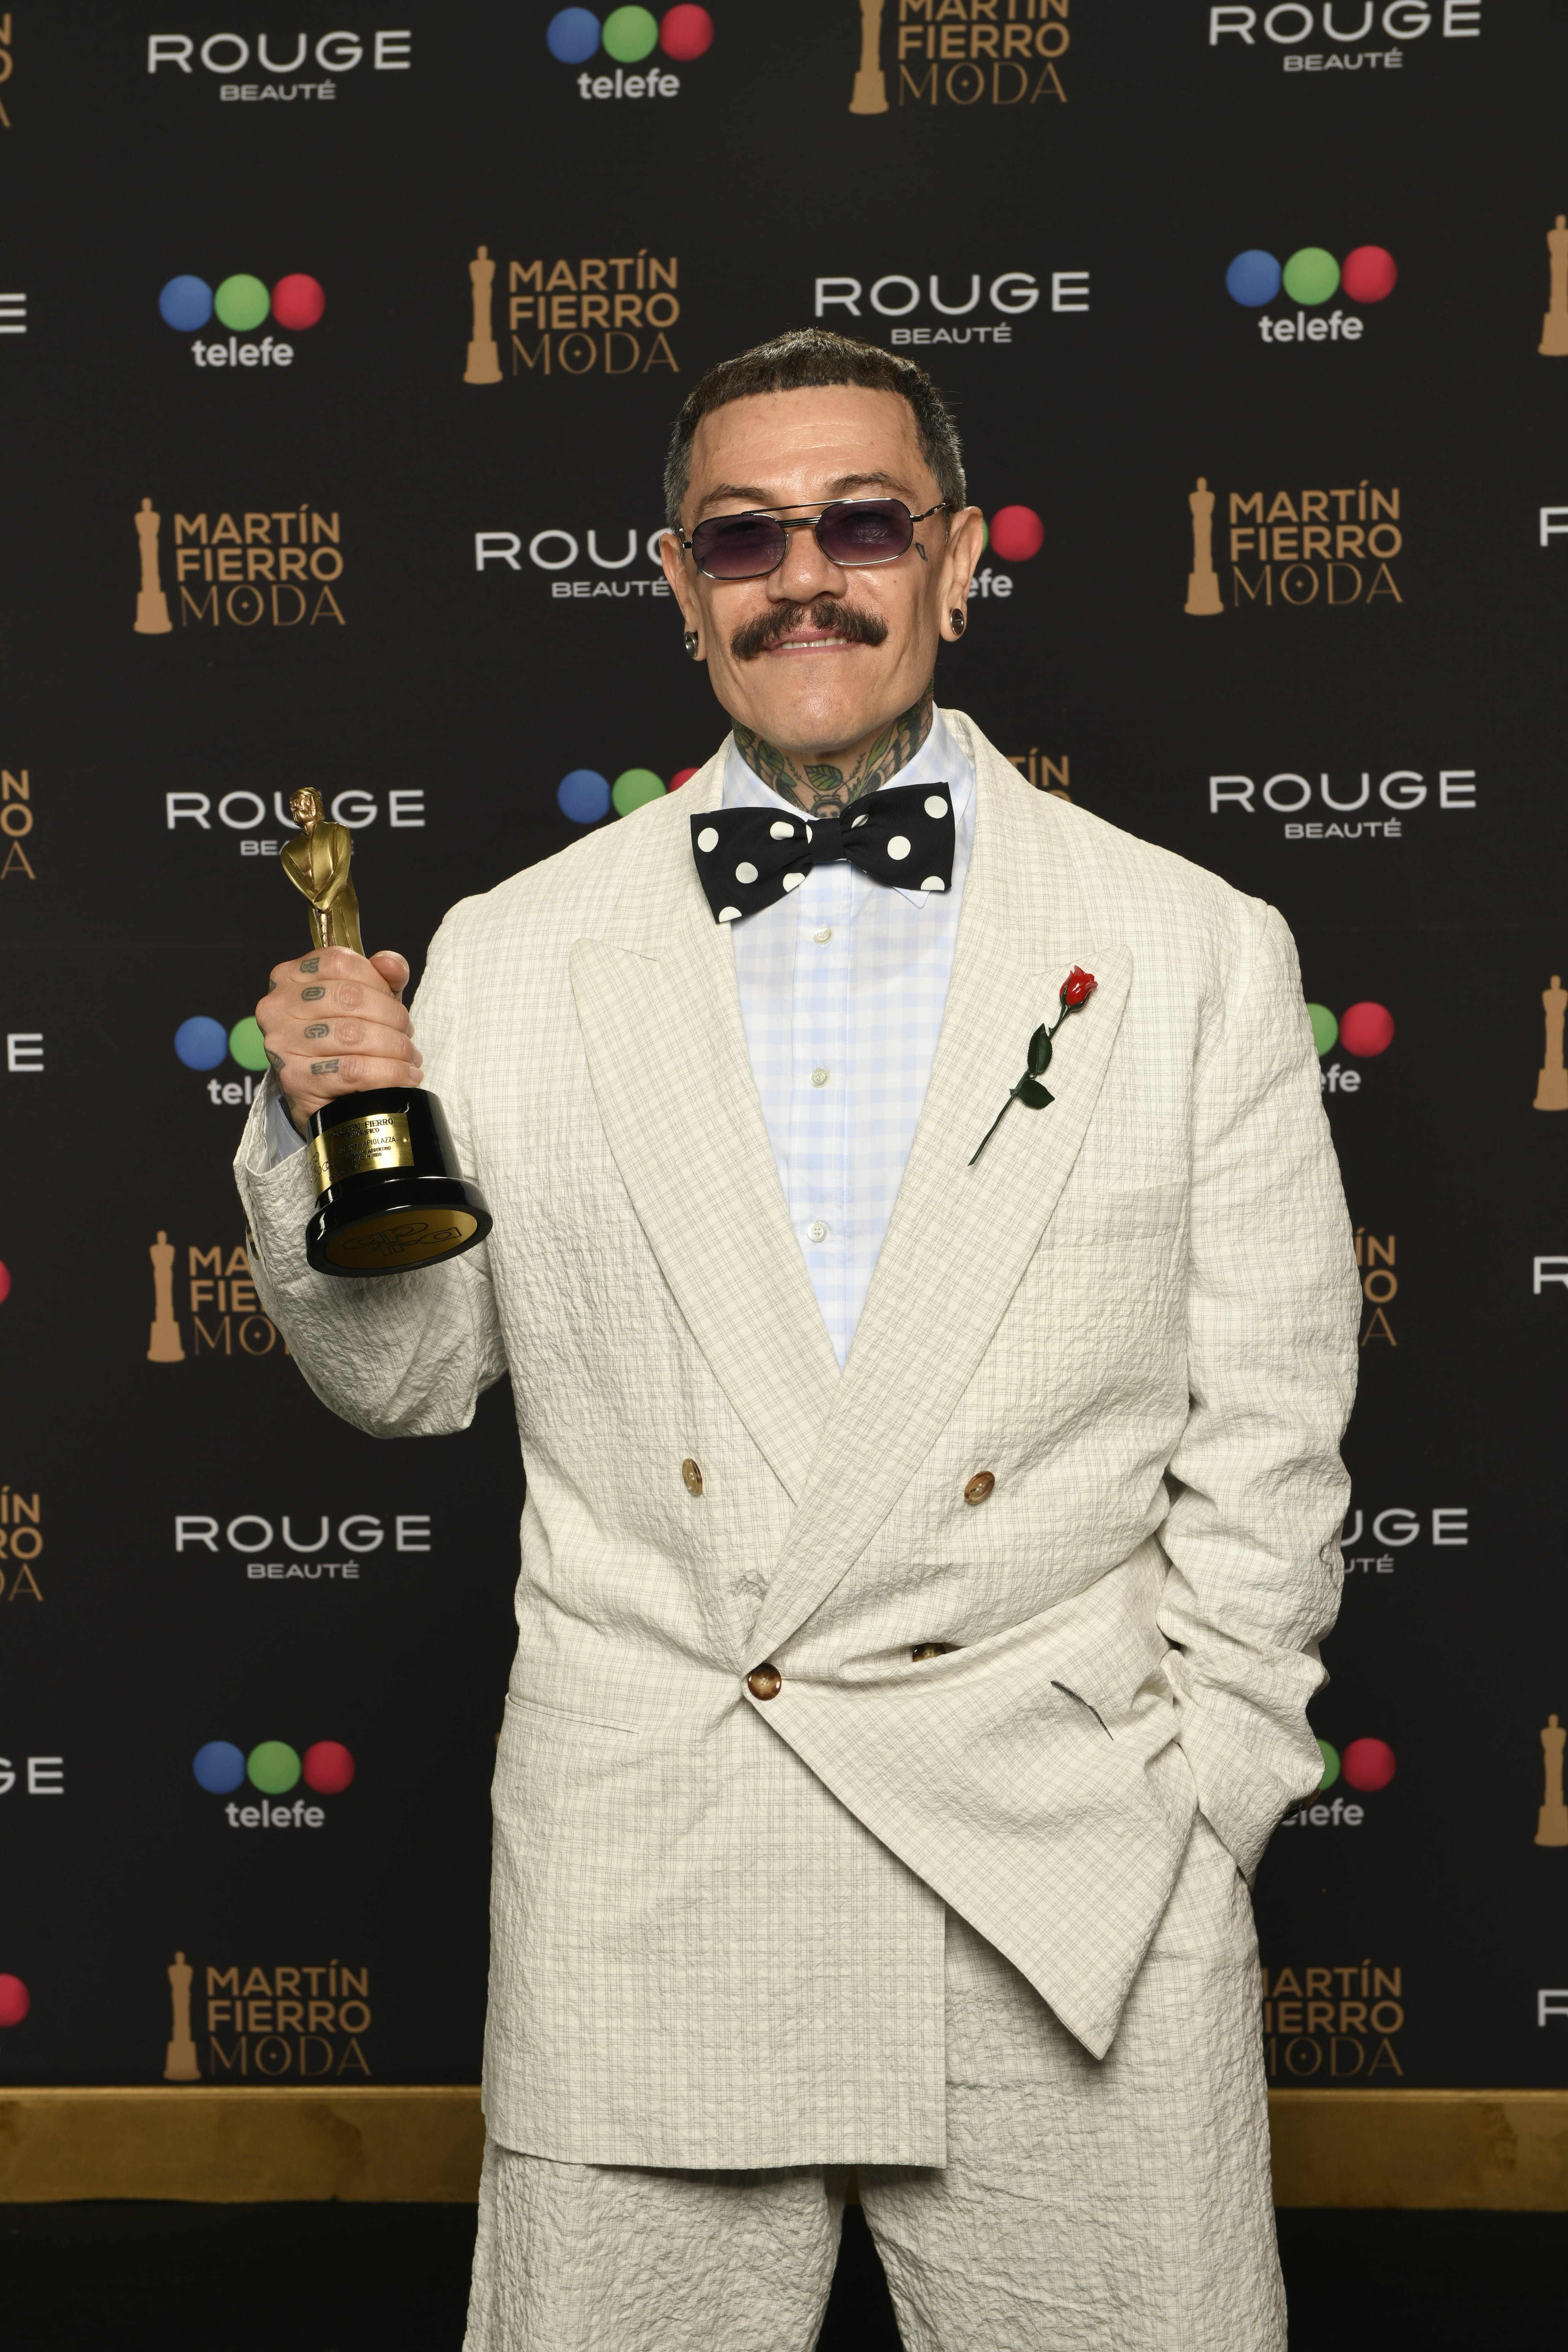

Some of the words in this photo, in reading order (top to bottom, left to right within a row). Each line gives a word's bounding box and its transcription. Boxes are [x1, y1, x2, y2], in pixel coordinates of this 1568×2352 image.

[899, 22, 1069, 59] FIERRO
[1209, 0, 1481, 46] ROUGE
[148, 30, 411, 73] ROUGE
[1283, 47, 1403, 72] BEAUTÉ
[220, 79, 335, 101] BEAUTÉ
[577, 68, 680, 99] telefe
[899, 61, 1068, 106] MODA
[509, 249, 677, 292] MARTÍN
[511, 293, 679, 330] FIERRO
[815, 272, 1089, 317] ROUGE
[891, 322, 1012, 345] BEAUTÉ
[1258, 310, 1363, 342] telefe
[191, 337, 293, 367] telefe
[511, 332, 680, 376] MODA
[1230, 480, 1399, 523] MARTÍN
[174, 504, 340, 545] MARTÍN
[1231, 523, 1402, 561] FIERRO
[177, 547, 343, 581] FIERRO
[475, 528, 670, 571] ROU
[552, 577, 670, 598] BEAUTÉ
[1232, 561, 1403, 607] MODA
[179, 584, 346, 626] MODA
[1209, 770, 1476, 813] ROUGE
[1285, 817, 1402, 839] BEAUTÉ
[364, 1118, 394, 1128] FIERRO
[175, 1515, 430, 1552] ROUGE
[247, 1560, 359, 1579] BEAUTÉ
[225, 1800, 324, 1827] telefe
[207, 1959, 368, 1996] MARTÍN
[1261, 1958, 1401, 1998] ARTÍN
[209, 2000, 370, 2032] FIERRO
[1264, 2000, 1404, 2034] IERRO
[209, 2035, 371, 2075] MODA
